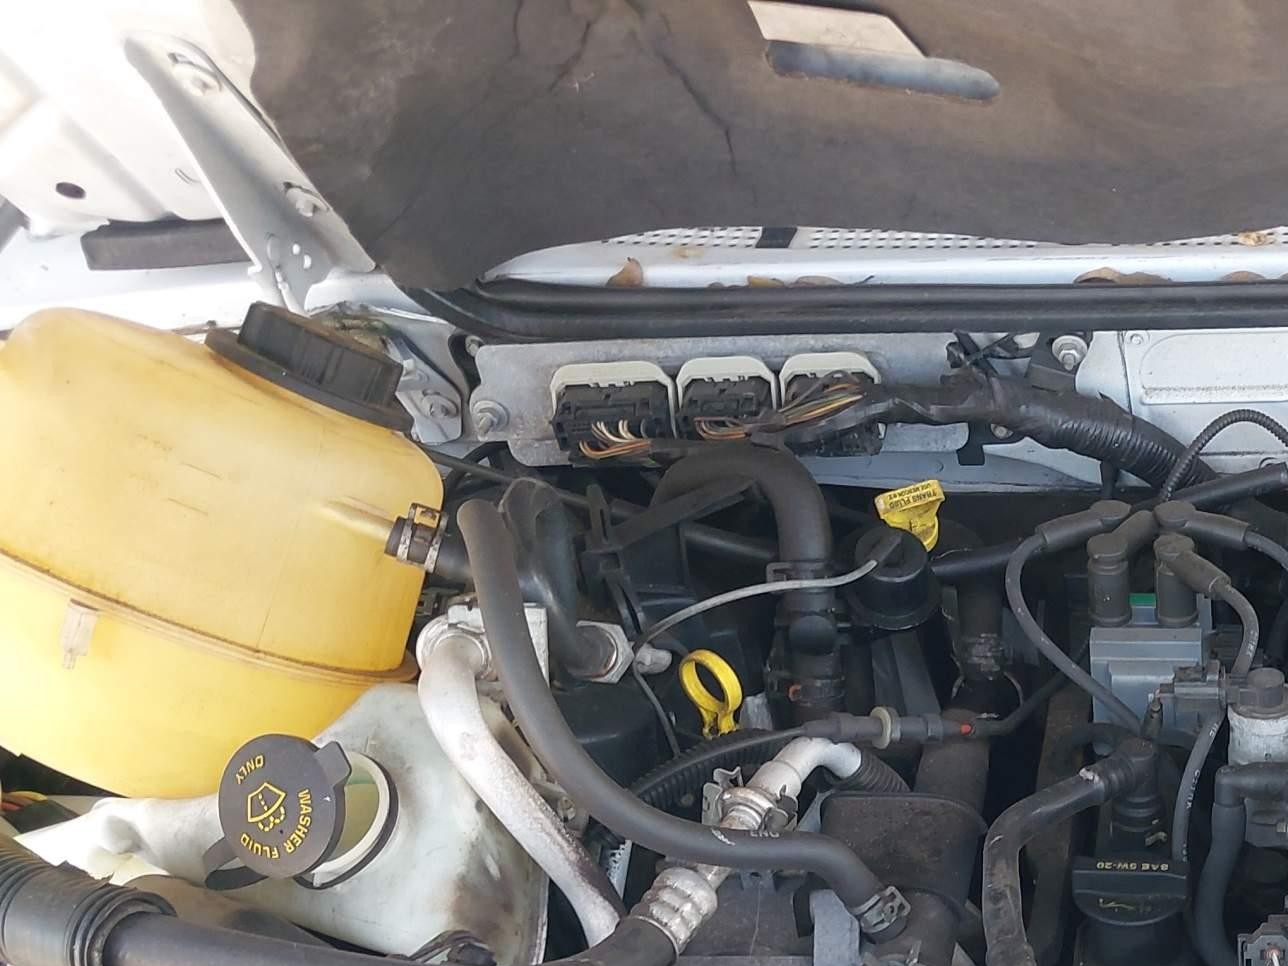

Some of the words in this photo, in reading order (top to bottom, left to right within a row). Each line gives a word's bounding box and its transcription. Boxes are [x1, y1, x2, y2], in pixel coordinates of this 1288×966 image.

[236, 755, 264, 785] ONLY
[284, 789, 313, 853] WASHER
[240, 833, 280, 859] FLUID
